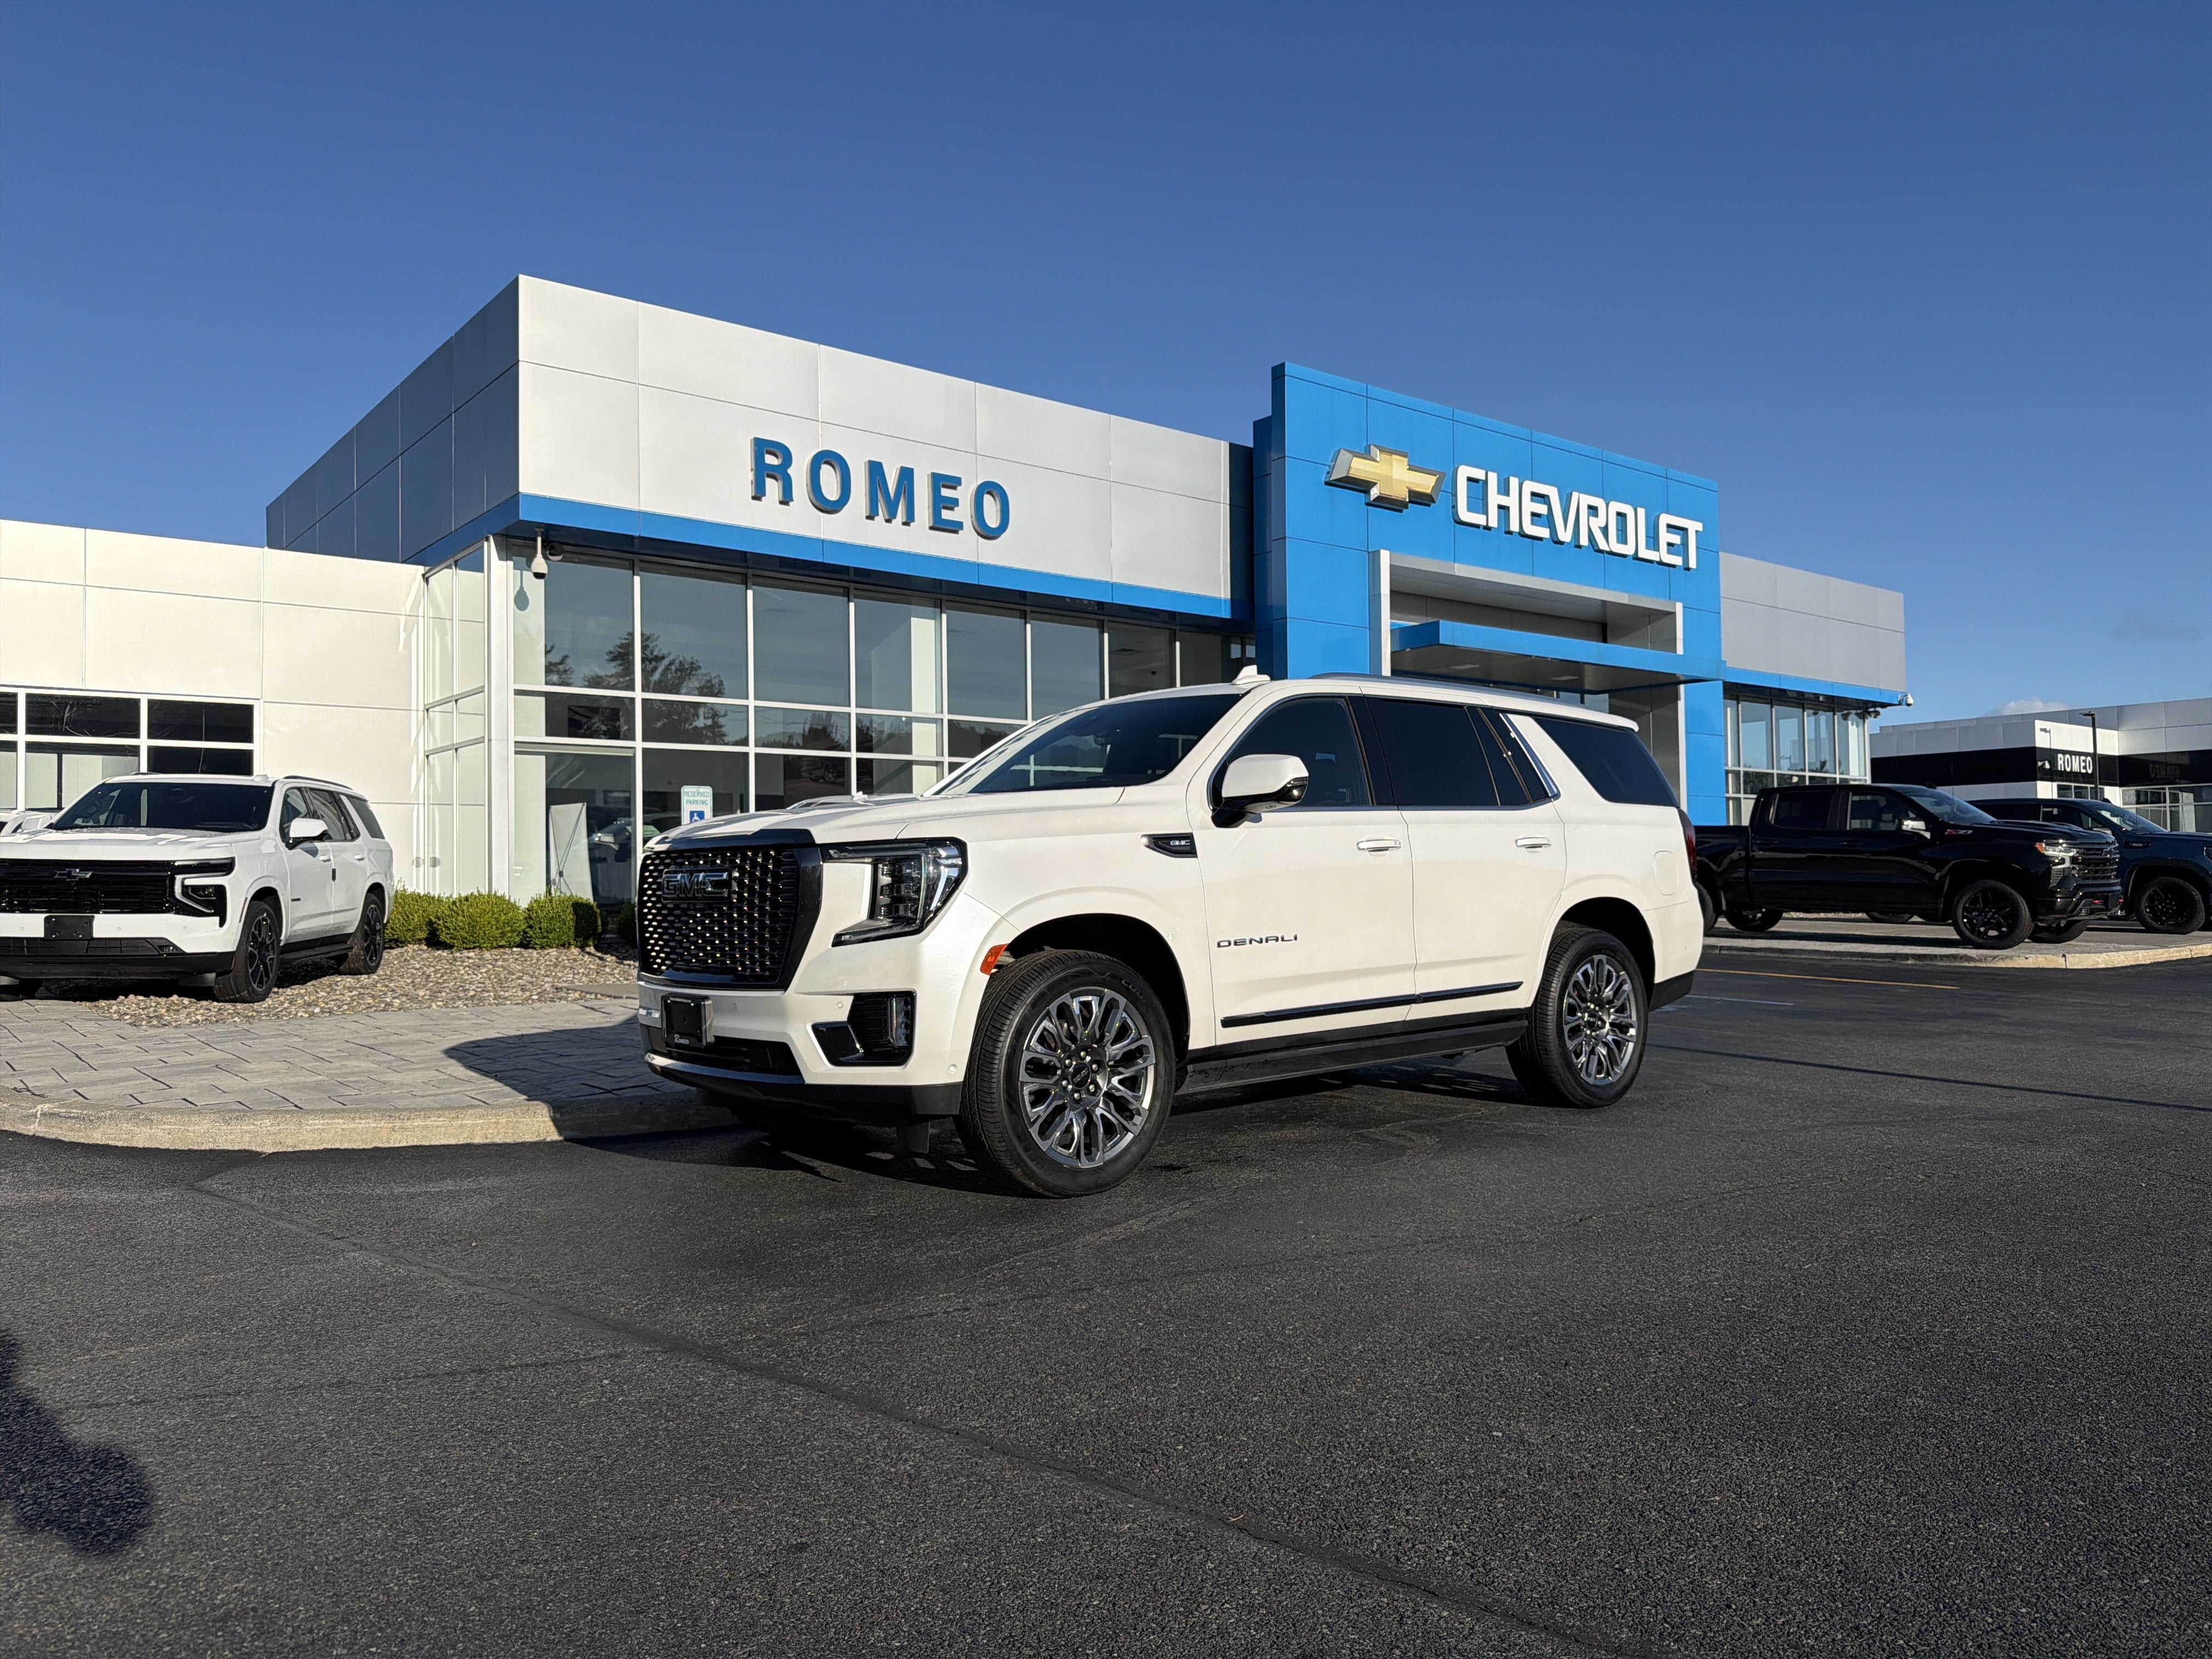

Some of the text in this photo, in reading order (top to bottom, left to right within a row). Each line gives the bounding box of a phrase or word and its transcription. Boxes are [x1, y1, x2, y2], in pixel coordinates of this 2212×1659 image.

[750, 437, 1011, 540] ROMEO
[1457, 465, 1703, 569] CHEVROLET
[2057, 753, 2093, 774] ROMEO
[663, 872, 728, 897] GMC
[1216, 934, 1297, 948] DENALI
